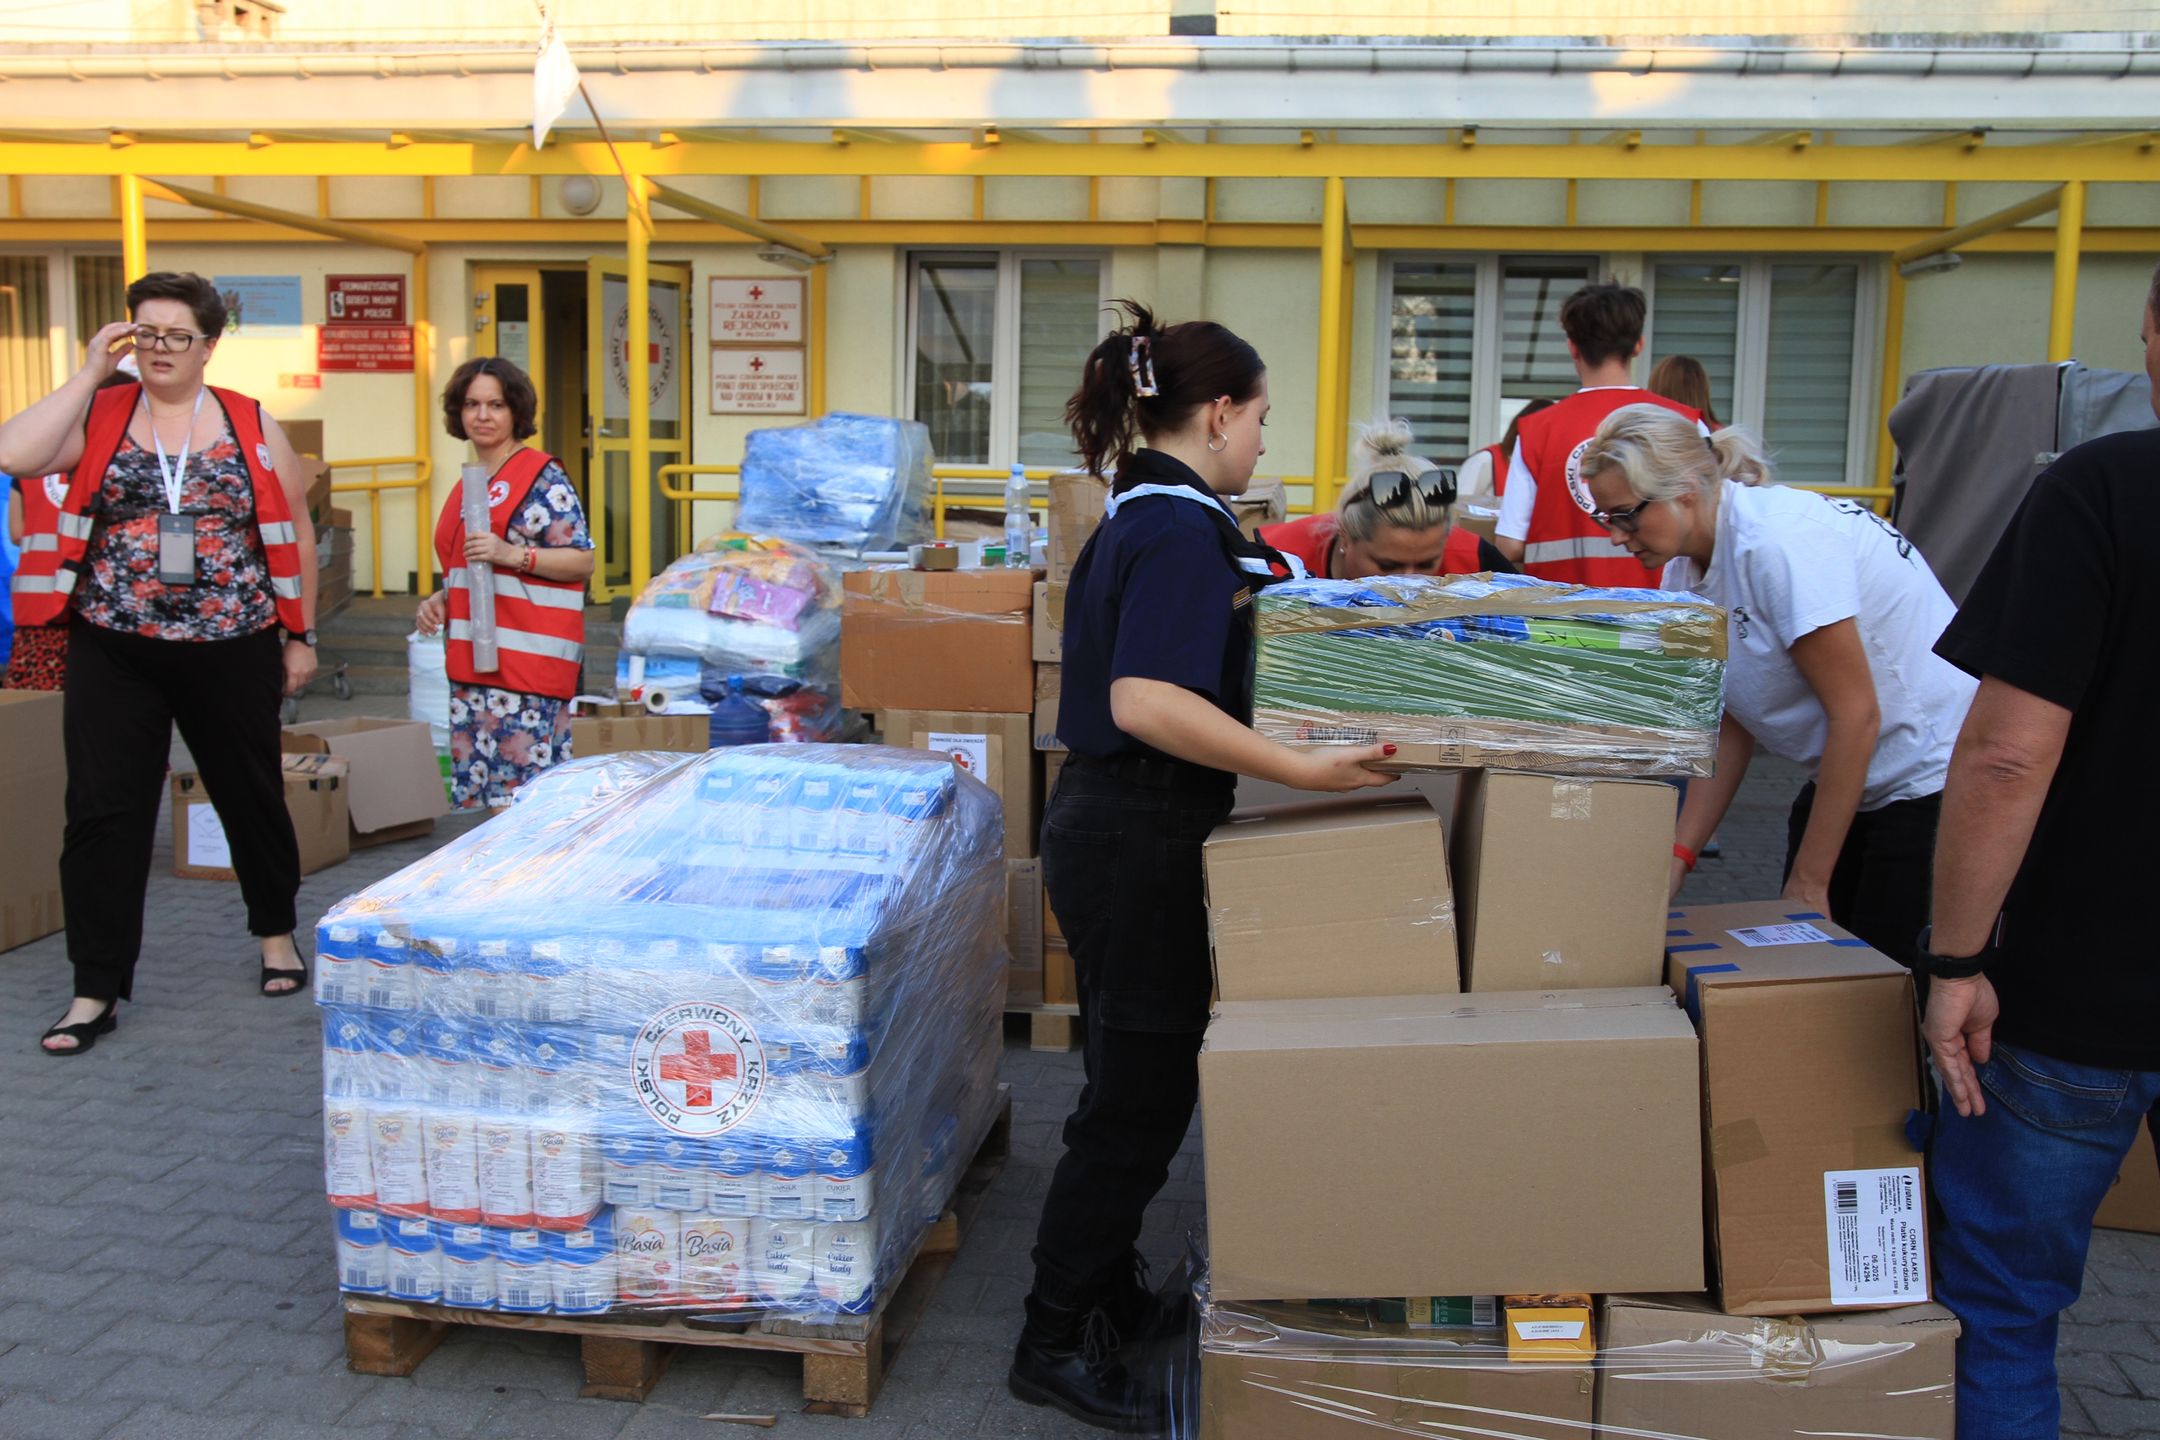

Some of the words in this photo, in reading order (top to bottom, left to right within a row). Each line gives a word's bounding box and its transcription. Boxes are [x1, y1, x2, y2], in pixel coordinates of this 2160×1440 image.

[1567, 468, 1592, 510] POLSKI
[644, 1006, 753, 1044] CZERWONY
[637, 1057, 682, 1125] POLSKI
[716, 1060, 759, 1126] KRZYŻ
[620, 1233, 664, 1254] Basia
[686, 1235, 733, 1257] Basia
[1909, 1228, 1918, 1251] CORN
[1863, 1262, 1871, 1283] 24294
[1871, 1254, 1880, 1282] 06.2025
[1901, 1242, 1909, 1291] kukurydziane
[1910, 1252, 1919, 1283] FLAKES
